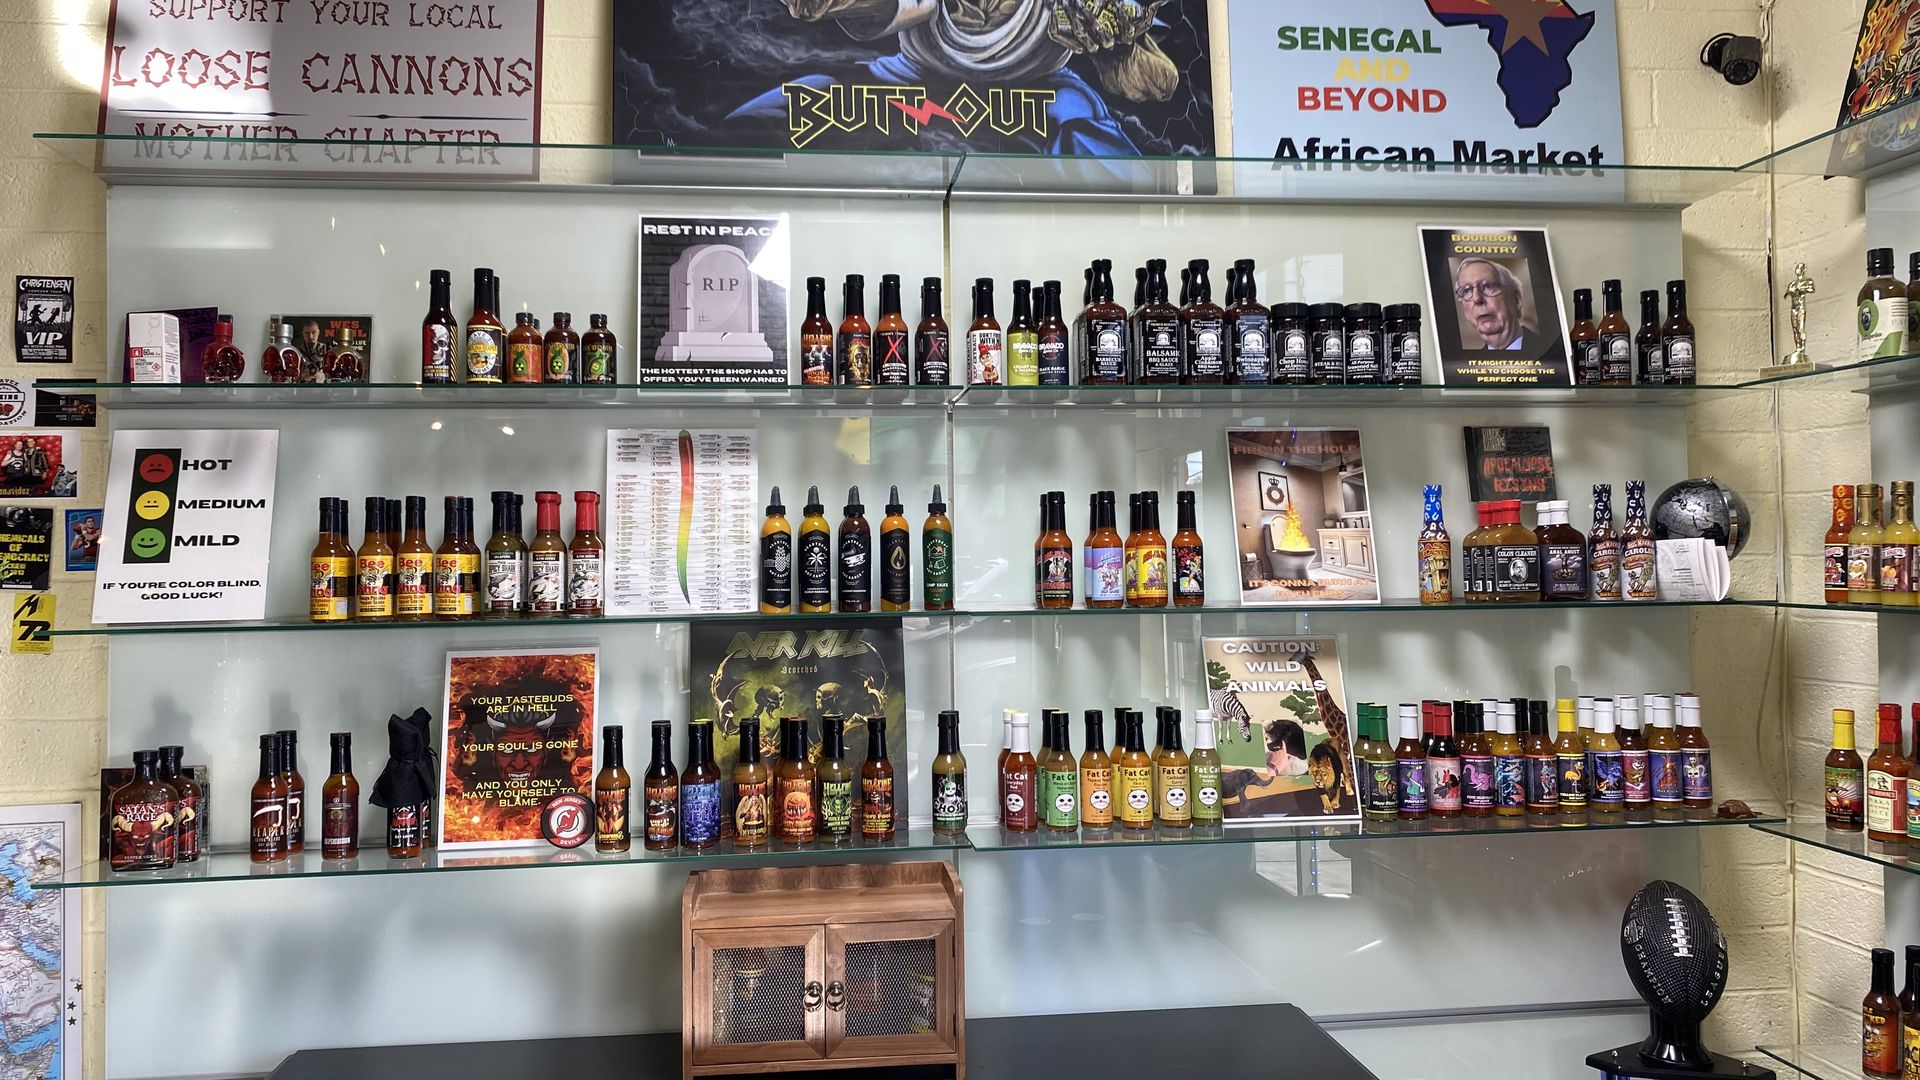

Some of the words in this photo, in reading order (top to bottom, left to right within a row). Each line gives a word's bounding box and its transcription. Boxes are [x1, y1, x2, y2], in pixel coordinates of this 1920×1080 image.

[148, 0, 290, 24] SUPPORT
[312, 0, 390, 27] YOUR
[408, 2, 503, 29] LOCAL
[1277, 25, 1442, 54] SENEGAL
[111, 45, 271, 90] LOOSE
[301, 53, 533, 97] CANNONS
[1334, 57, 1411, 83] AND
[1298, 86, 1447, 113] BEYOND
[782, 83, 927, 149] BUTT
[944, 82, 1056, 137] OUT
[133, 122, 300, 162] MOTHER
[323, 126, 501, 165] CHAPTER
[1271, 137, 1435, 174] African
[1454, 141, 1604, 177] Market
[644, 225, 692, 235] REST
[695, 226, 716, 236] IN
[718, 227, 772, 236] PEAC
[1452, 234, 1518, 243] BOURBON
[1455, 246, 1518, 254] COUNTRY
[20, 279, 71, 293] CHRISTENSEN
[26, 332, 63, 345] VIP
[1287, 446, 1314, 454] THE
[1317, 445, 1358, 453] HOLE
[182, 459, 232, 471] HOT
[1483, 456, 1553, 476] APOCALYPSE
[1494, 478, 1546, 493] RISING
[177, 499, 266, 509] MEDIUM
[174, 535, 240, 547] MILD
[9, 543, 23, 552] OF
[360, 559, 385, 568] Bee
[399, 558, 423, 567] Bee
[103, 582, 116, 590] IF
[169, 580, 215, 588] COLOR
[217, 580, 262, 588] BLIND,
[1272, 579, 1316, 587] GONNA
[141, 592, 180, 600] GOOD
[182, 591, 223, 600] LUCK!
[1223, 642, 1319, 654] CAUTION:
[781, 665, 818, 675] Scorched
[1246, 661, 1301, 673] WILD
[1226, 680, 1327, 692] ANIMALS
[471, 697, 502, 705] YOUR
[505, 694, 573, 704] TASTEBUDS
[486, 705, 509, 713] ARE
[513, 705, 524, 713] IN
[528, 704, 557, 712] HELL
[463, 743, 494, 752] YOUR
[497, 742, 528, 751] SOUL
[532, 741, 543, 750] IS
[546, 740, 578, 749] GONE
[475, 781, 500, 790] AND
[504, 780, 528, 789] YOU
[531, 779, 562, 788] ONLY
[462, 790, 493, 799] HAVE
[496, 788, 557, 798] YOURSELF
[499, 798, 541, 807] BLAME.
[119, 804, 165, 816] SATAN'S
[126, 813, 157, 822] RAGE
[253, 826, 284, 838] REAPER
